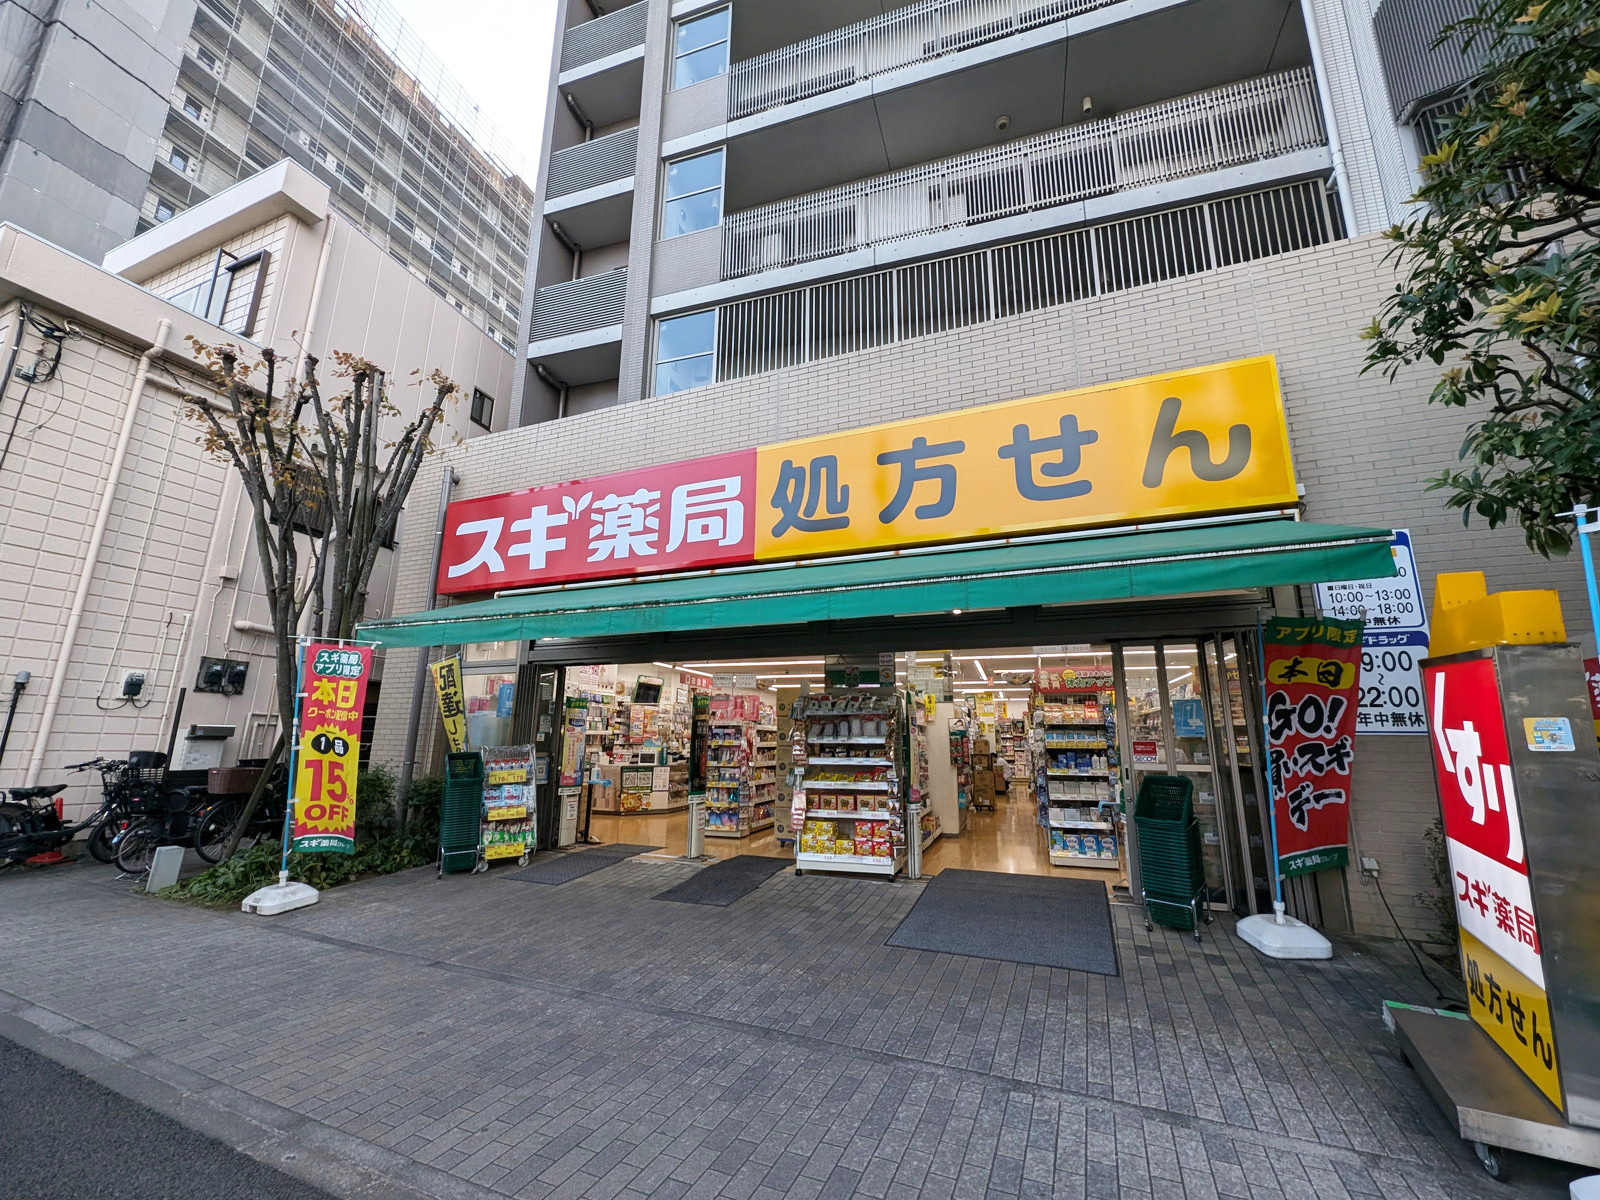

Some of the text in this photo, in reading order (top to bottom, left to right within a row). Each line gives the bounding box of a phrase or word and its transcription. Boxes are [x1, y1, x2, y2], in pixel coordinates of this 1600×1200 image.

[770, 397, 1253, 538] 処方せん
[447, 475, 745, 580] スギ薬局
[1276, 624, 1358, 644] アプリ限定
[316, 663, 362, 676] アプリ限定
[319, 652, 359, 665] スギ薬局
[1277, 657, 1344, 688] 本日
[1361, 650, 1413, 673] 9:00
[311, 678, 359, 709] 本日
[1268, 690, 1346, 743] GO!
[1434, 671, 1524, 864] くすり
[304, 804, 349, 822] OFF
[1288, 783, 1343, 828] デー
[1456, 870, 1542, 955] スギ薬局
[1466, 953, 1553, 1070] 処方せん
